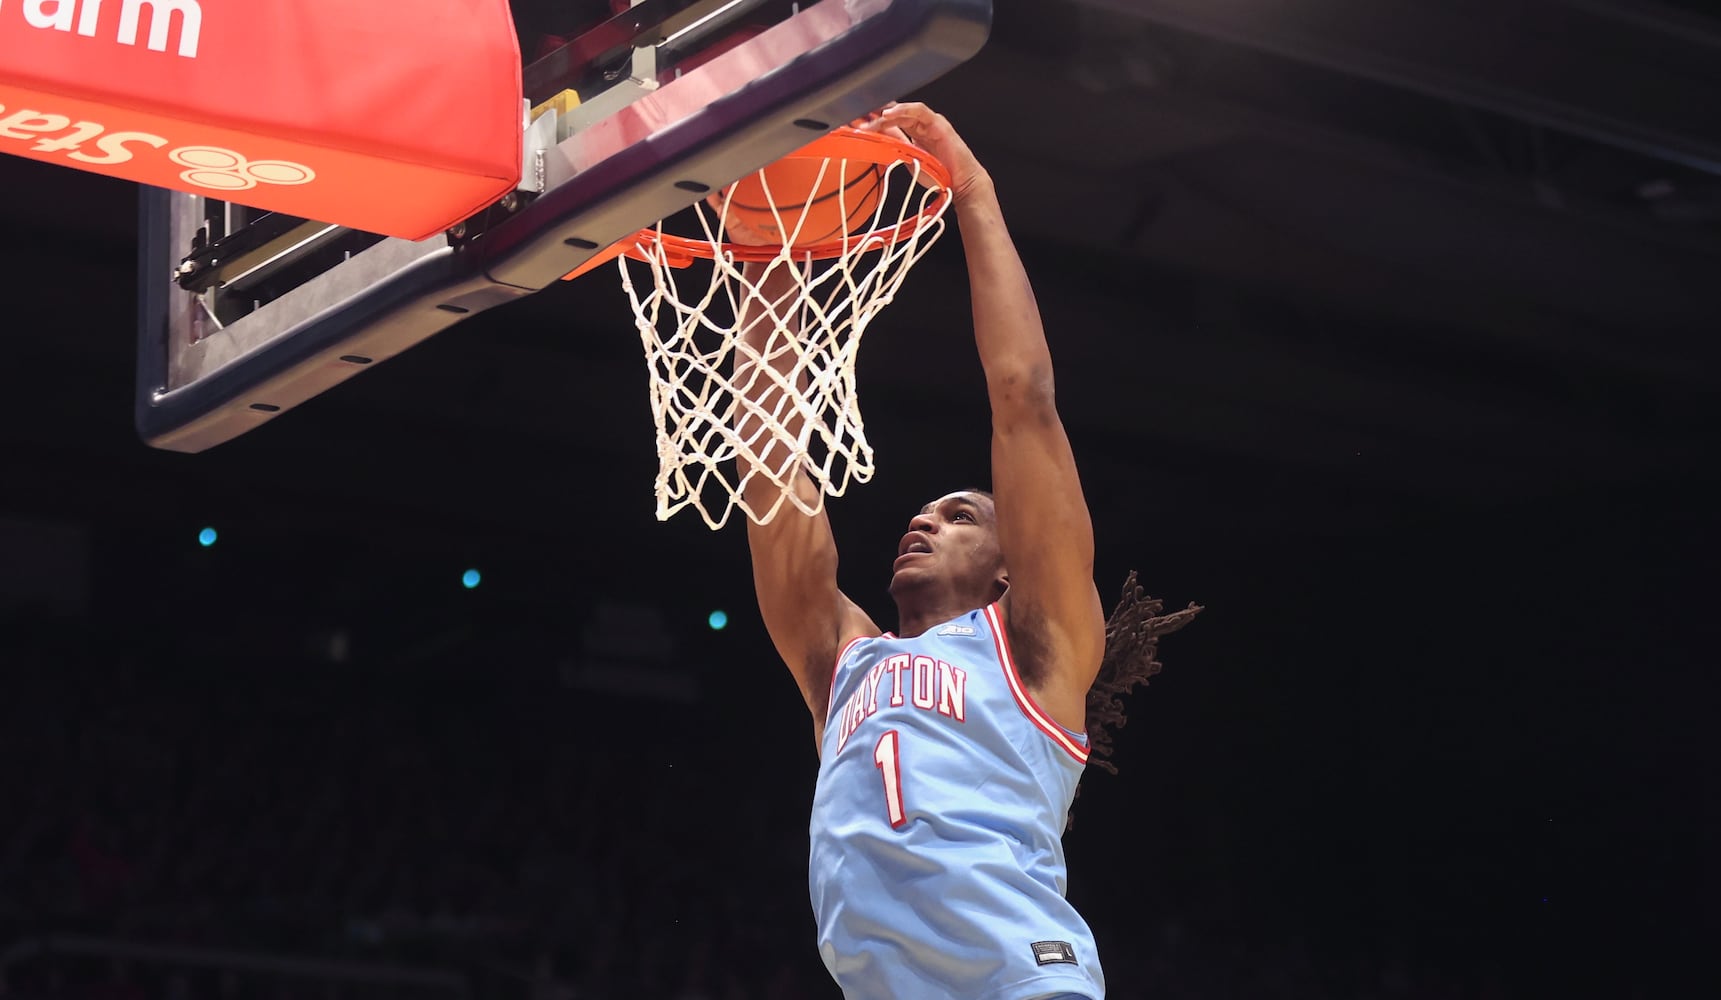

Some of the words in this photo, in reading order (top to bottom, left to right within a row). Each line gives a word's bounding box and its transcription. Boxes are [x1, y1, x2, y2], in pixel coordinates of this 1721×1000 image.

[0, 0, 203, 58] arm
[0, 104, 168, 164] Sta
[837, 653, 967, 756] DAYTON
[874, 730, 907, 829] 1
